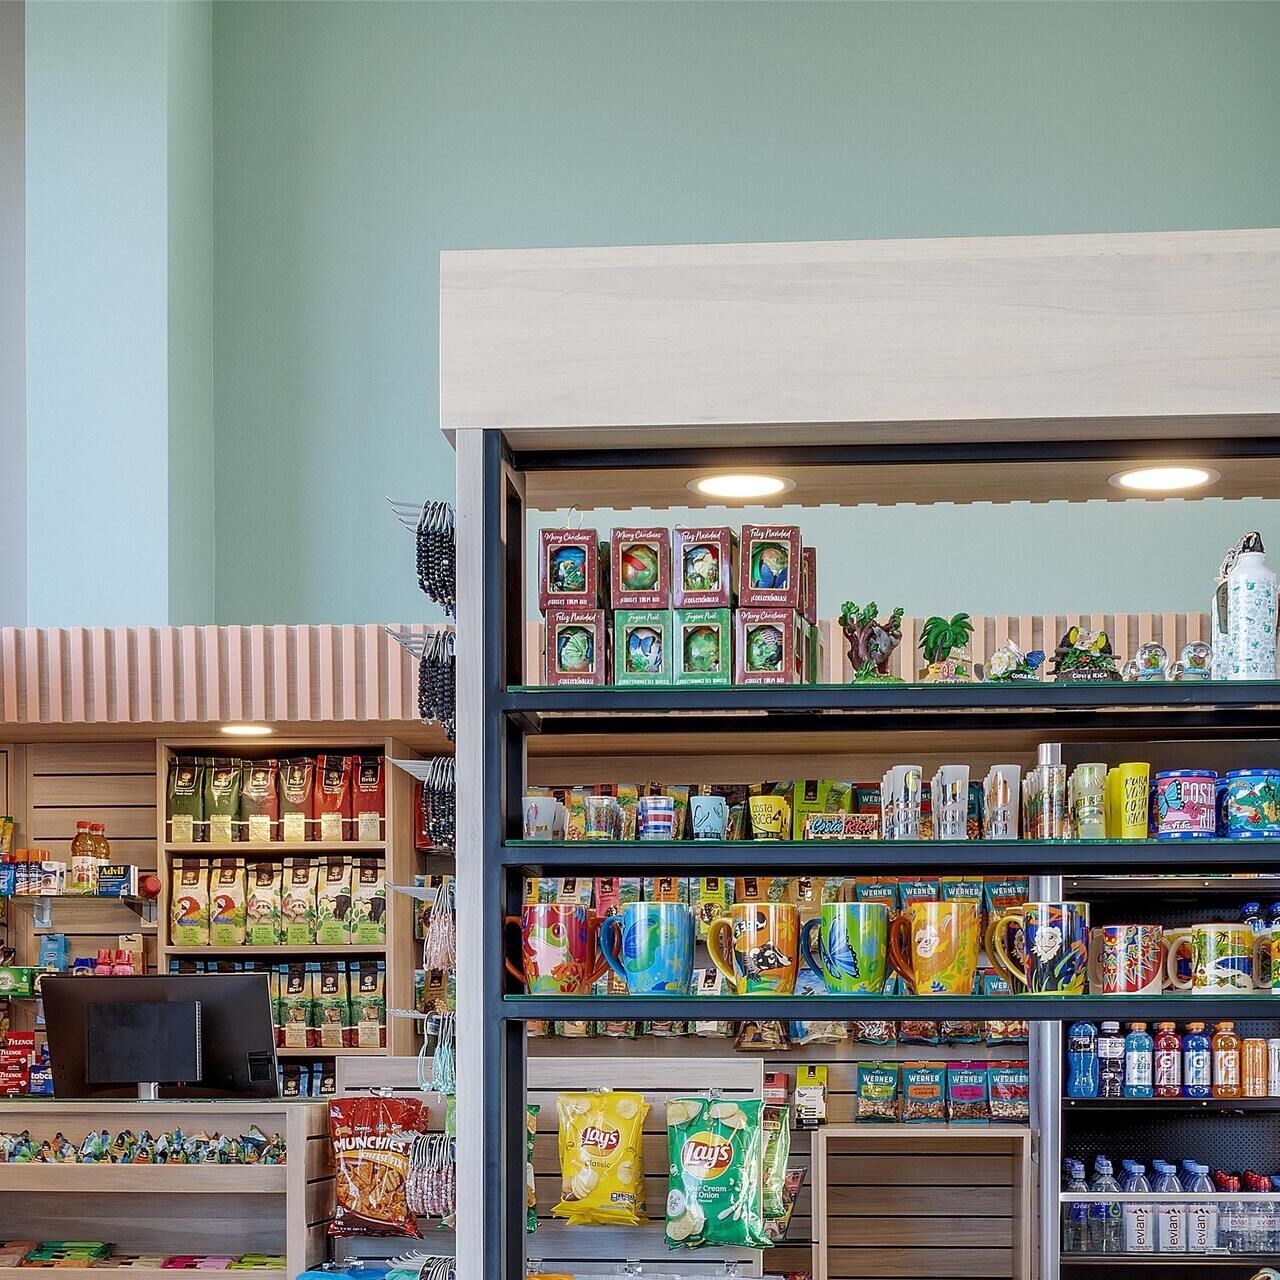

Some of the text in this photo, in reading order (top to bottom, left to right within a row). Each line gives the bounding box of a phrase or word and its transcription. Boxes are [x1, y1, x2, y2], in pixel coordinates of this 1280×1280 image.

[101, 867, 124, 876] Advil
[862, 889, 892, 897] WERNER
[906, 888, 936, 896] WERNER
[8, 1038, 34, 1046] TYLENOL
[862, 1074, 894, 1083] WERNER
[908, 1074, 940, 1083] WERNER
[952, 1076, 982, 1084] WERNER
[582, 1128, 618, 1150] Lay's
[333, 1136, 406, 1152] MUNCHIES
[684, 1140, 730, 1169] Lay's
[584, 1160, 612, 1168] Classic
[702, 1184, 727, 1192] Cream
[698, 1192, 720, 1200] Onion
[1136, 1214, 1146, 1246] evian
[1170, 1214, 1178, 1248] evian
